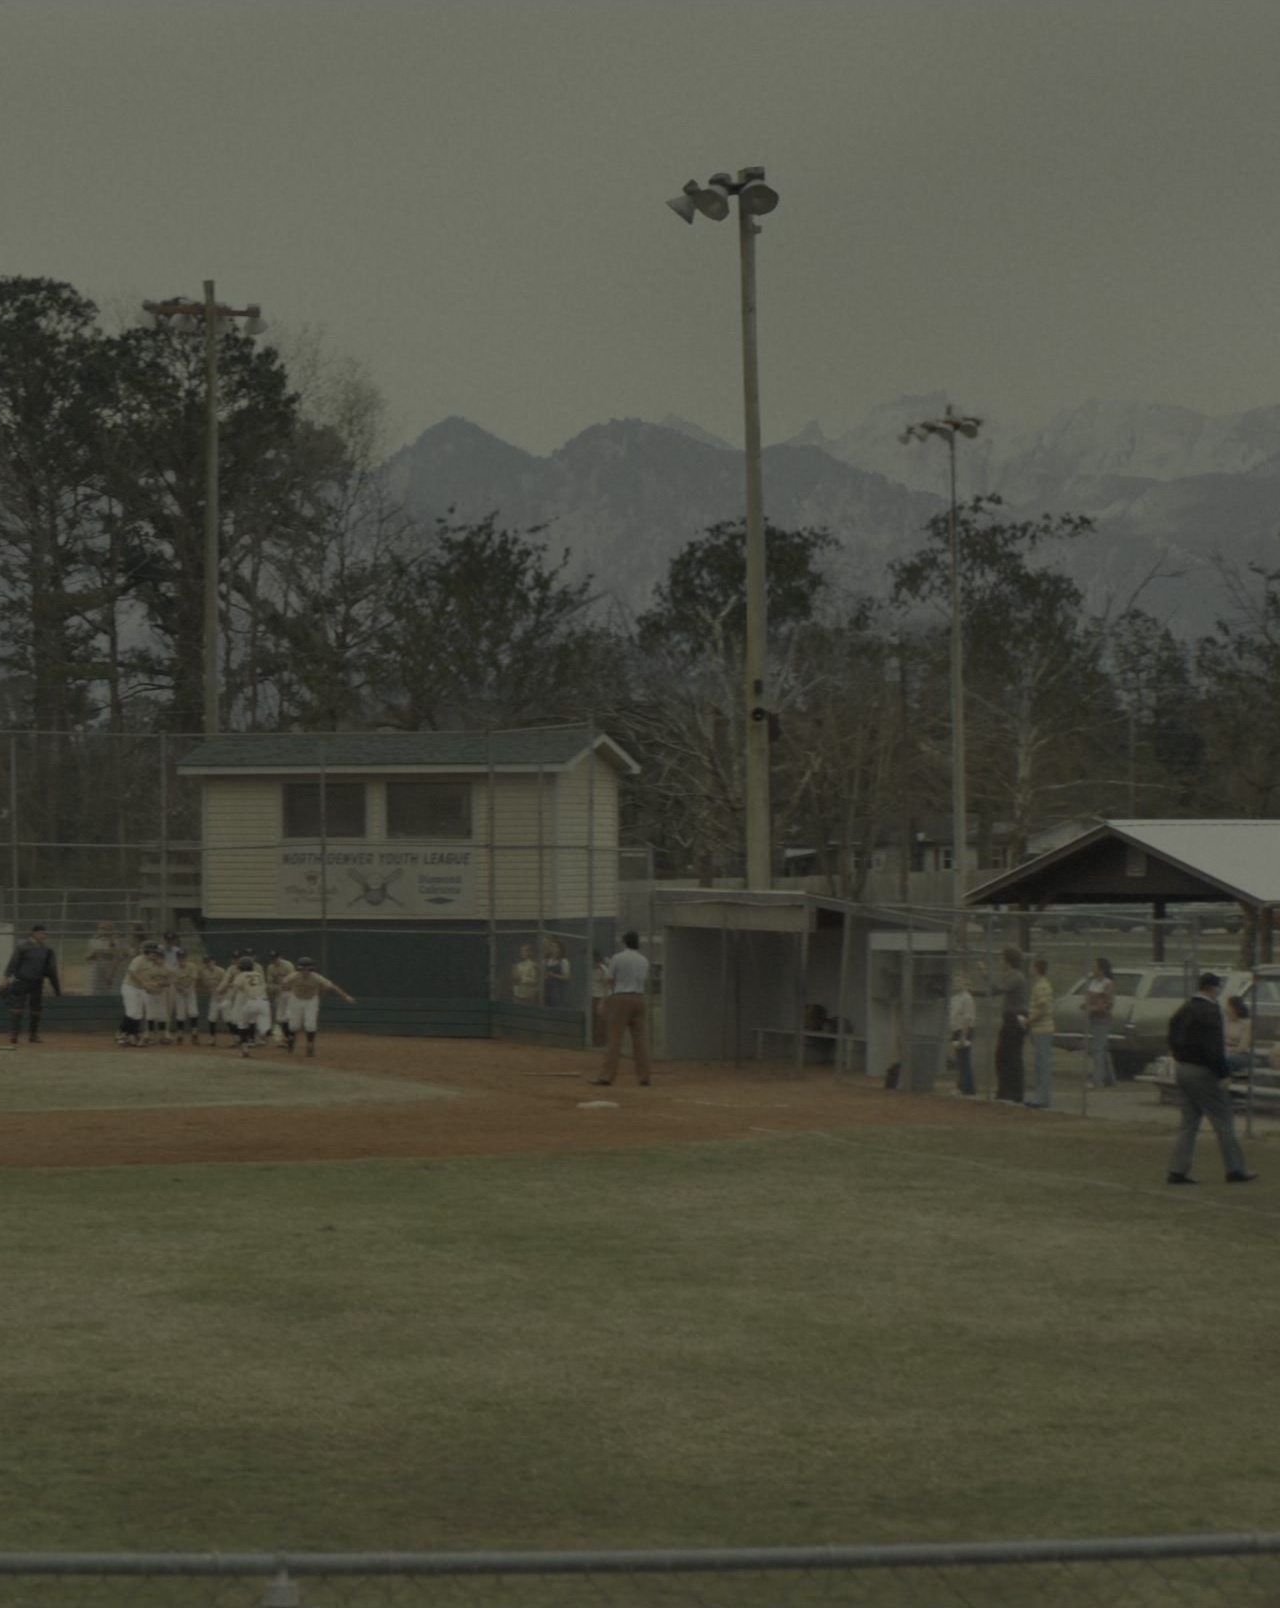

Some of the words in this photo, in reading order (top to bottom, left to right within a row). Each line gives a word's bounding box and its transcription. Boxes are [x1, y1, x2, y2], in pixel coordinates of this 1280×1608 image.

[283, 852, 322, 865] NORTH
[326, 852, 374, 865] DENVER
[378, 852, 419, 865] YOUTH
[424, 852, 472, 865] LEAGUE
